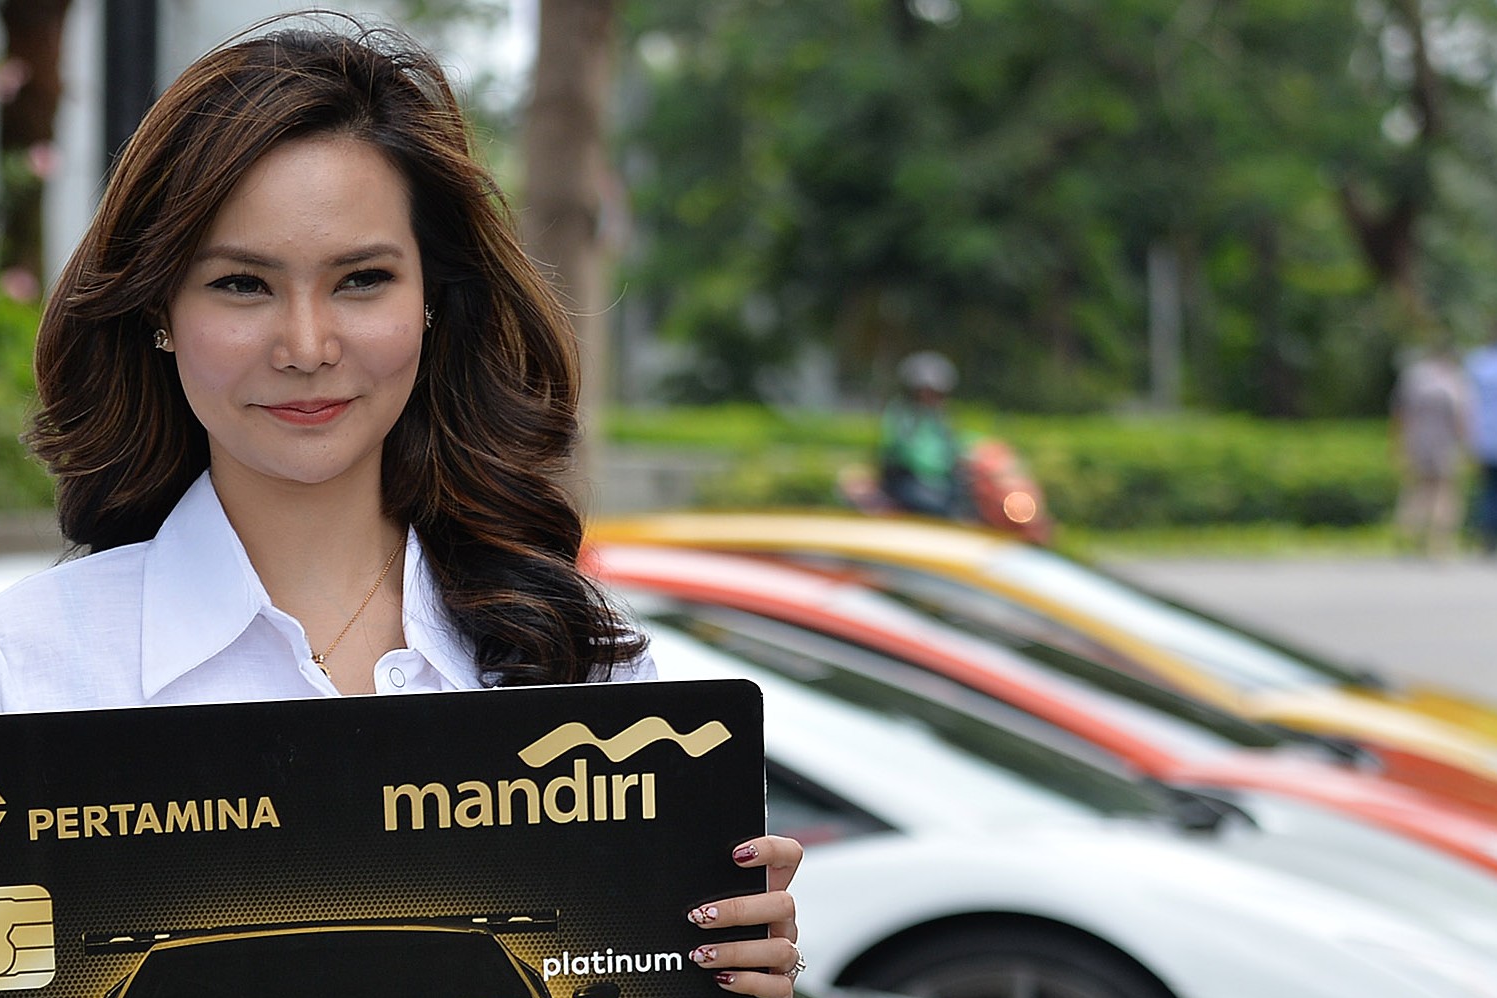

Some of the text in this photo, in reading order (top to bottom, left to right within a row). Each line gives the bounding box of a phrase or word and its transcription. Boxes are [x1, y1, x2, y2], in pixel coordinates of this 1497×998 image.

[383, 758, 656, 831] mandiri
[28, 796, 280, 840] PERTAMINA
[542, 948, 682, 980] platinum
